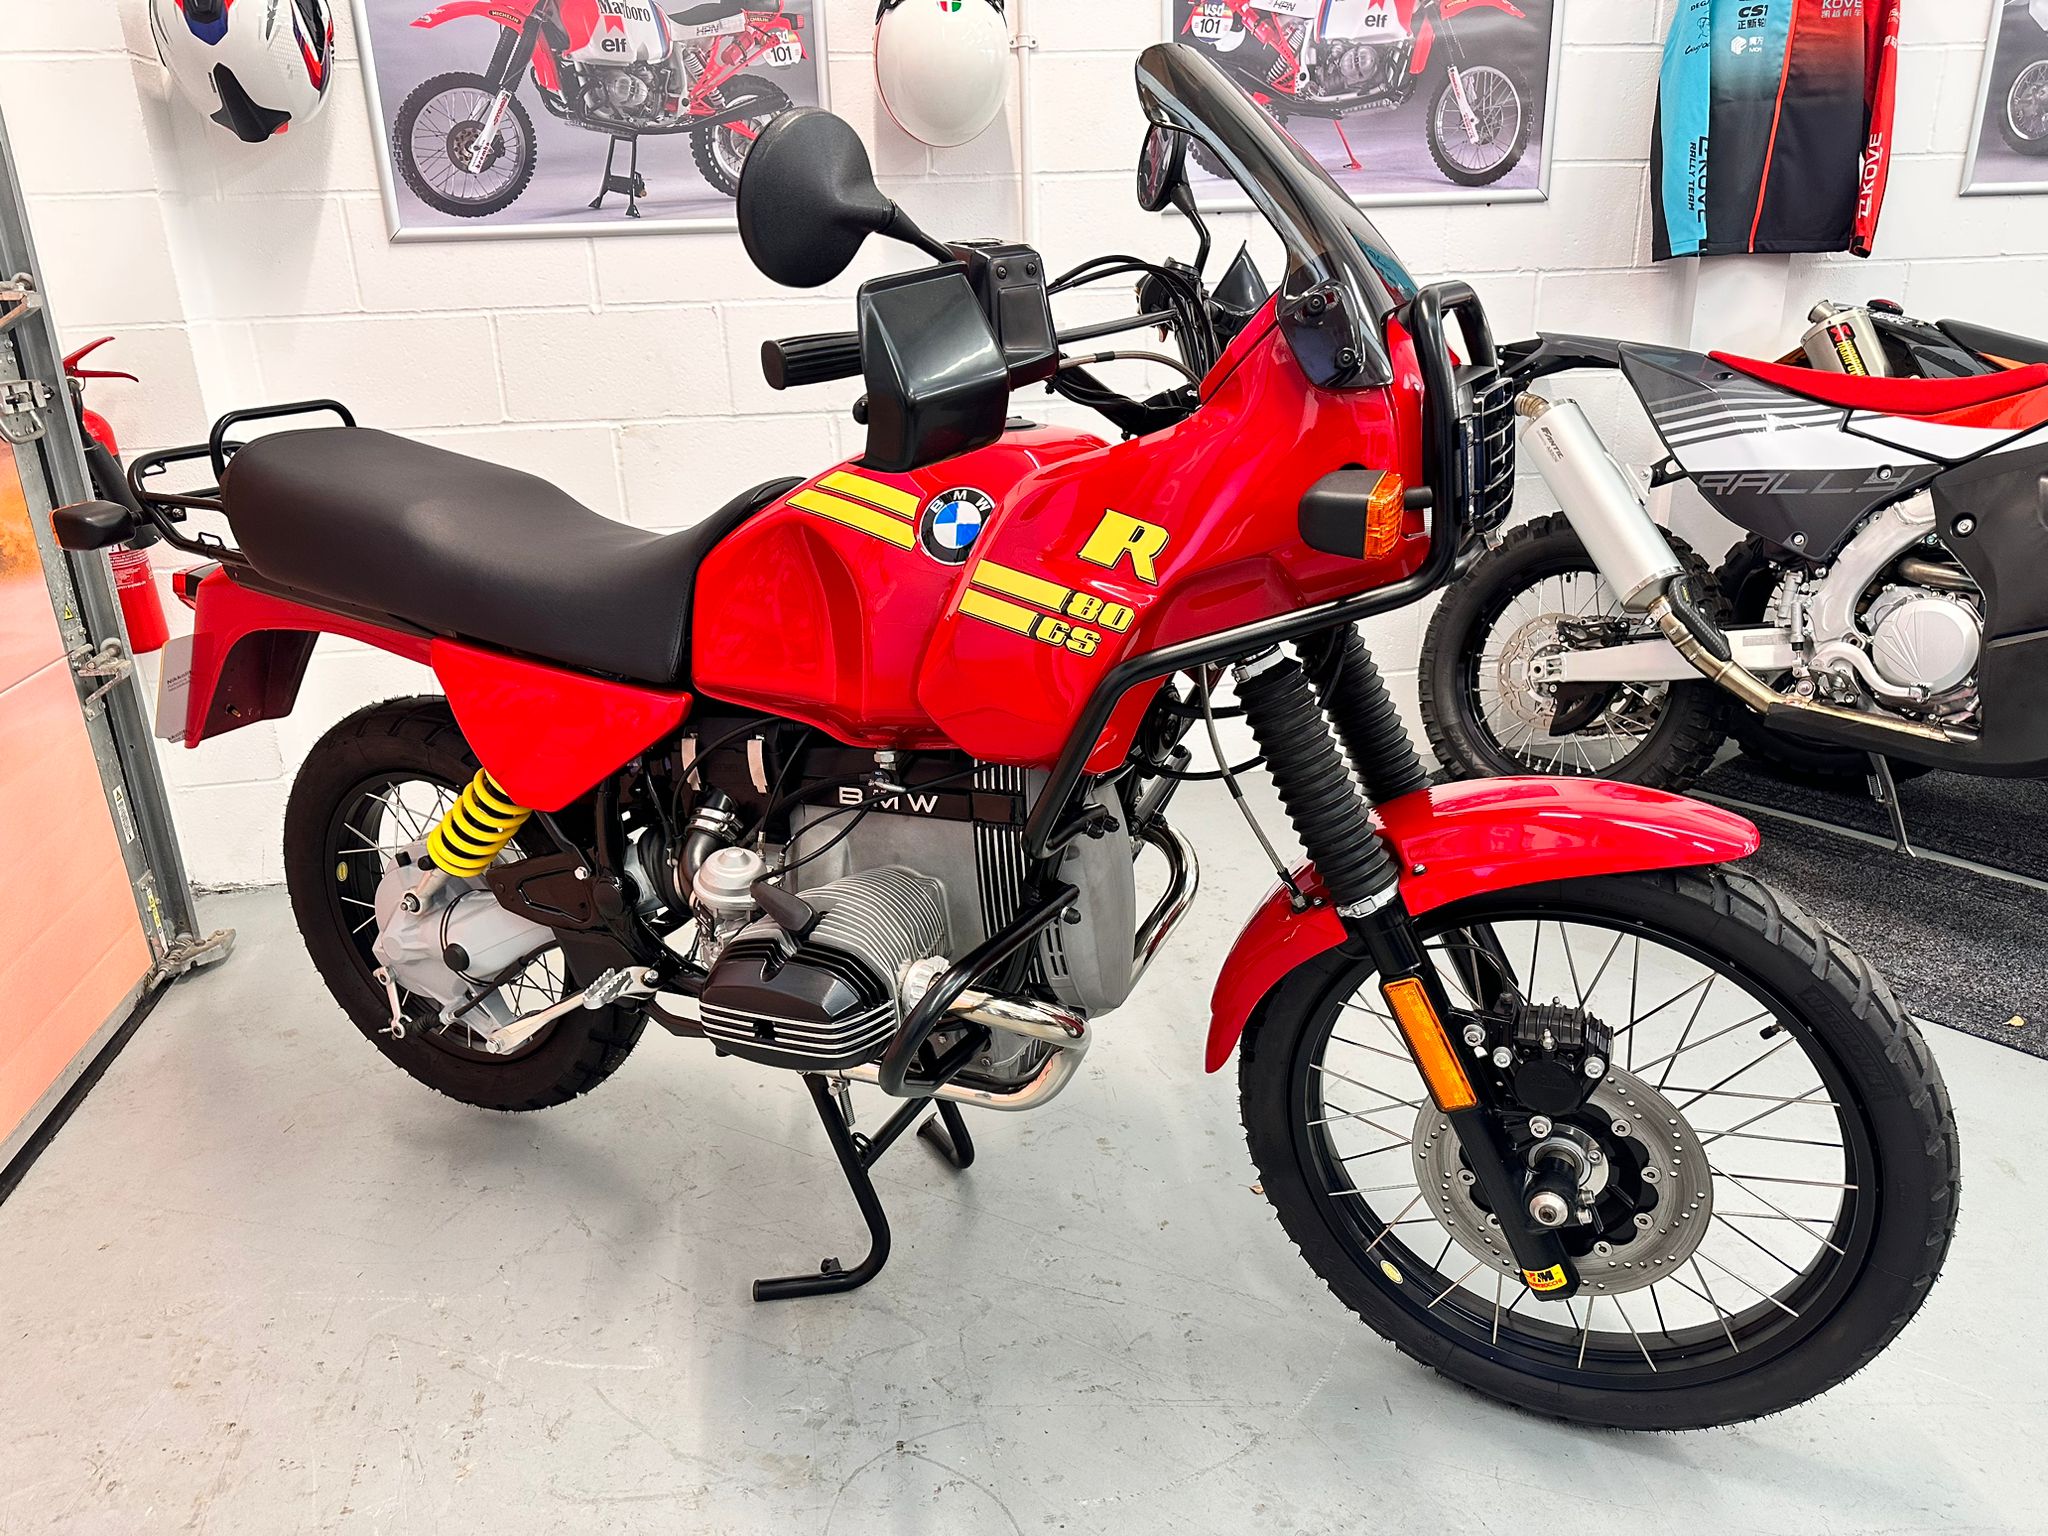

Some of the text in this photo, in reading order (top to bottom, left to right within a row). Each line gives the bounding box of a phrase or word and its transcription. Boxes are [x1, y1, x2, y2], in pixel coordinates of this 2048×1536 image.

[491, 11, 520, 23] MICHELIN
[1204, 3, 1225, 17] vsd
[1822, 0, 1863, 9] KOVE
[1200, 18, 1221, 34] 101
[1364, 14, 1388, 28] elf
[601, 38, 627, 53] elf
[770, 46, 793, 62] 101
[1687, 142, 1697, 211] RALLY TEAM
[1861, 132, 1883, 195] KOVE
[1541, 427, 1564, 459] FANTIC
[1699, 467, 1916, 496] RALLY
[930, 490, 991, 514] BMW
[1078, 508, 1170, 586] R
[1066, 591, 1136, 634] 80
[1035, 616, 1103, 658] GS
[839, 786, 939, 814] BMW
